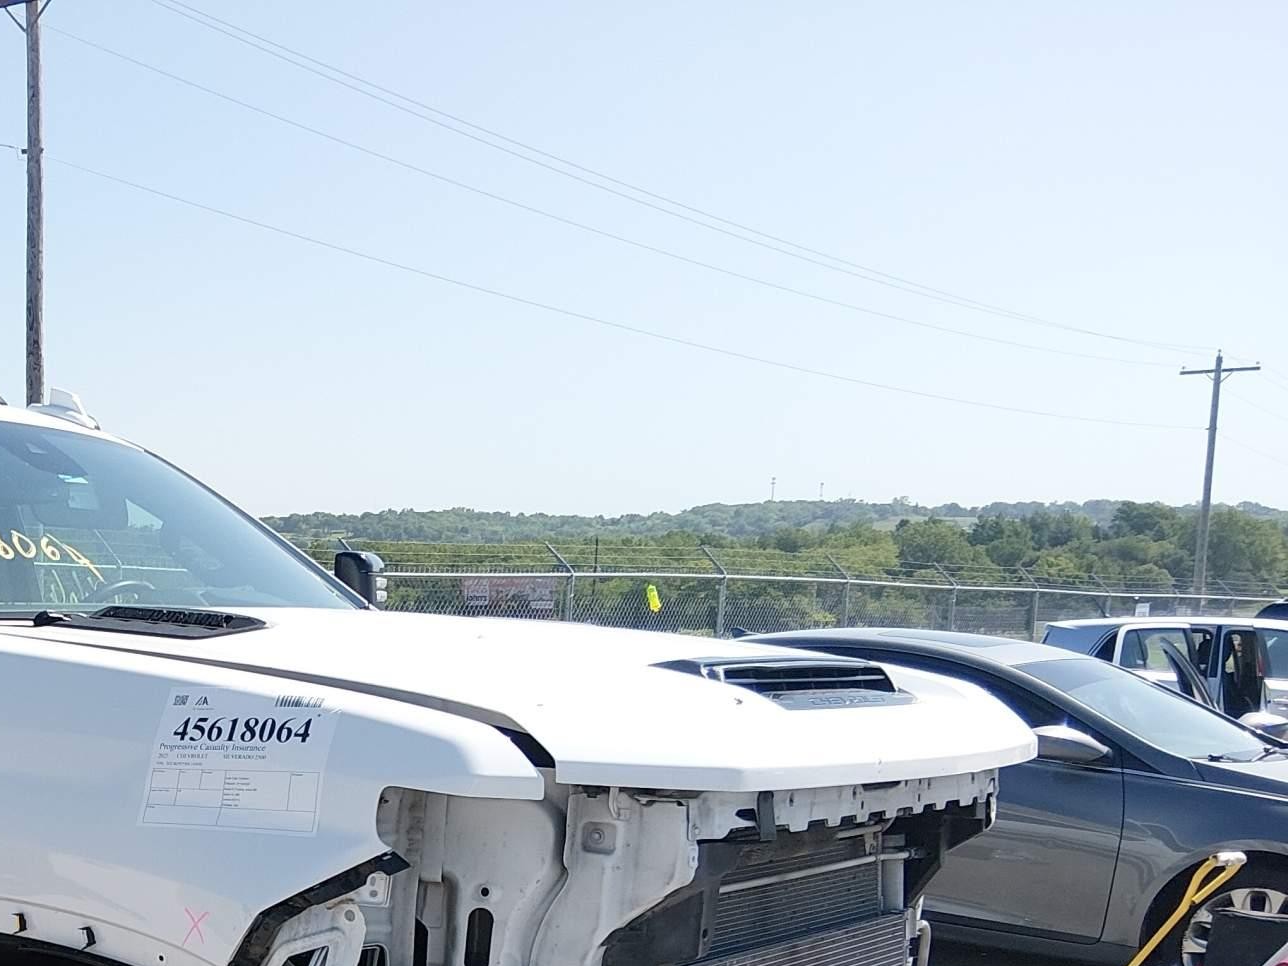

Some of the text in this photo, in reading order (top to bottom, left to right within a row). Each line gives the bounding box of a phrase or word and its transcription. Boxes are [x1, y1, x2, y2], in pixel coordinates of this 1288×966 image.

[173, 716, 312, 743] 45618064
[159, 743, 266, 752] Progressive Casualty Insurance
